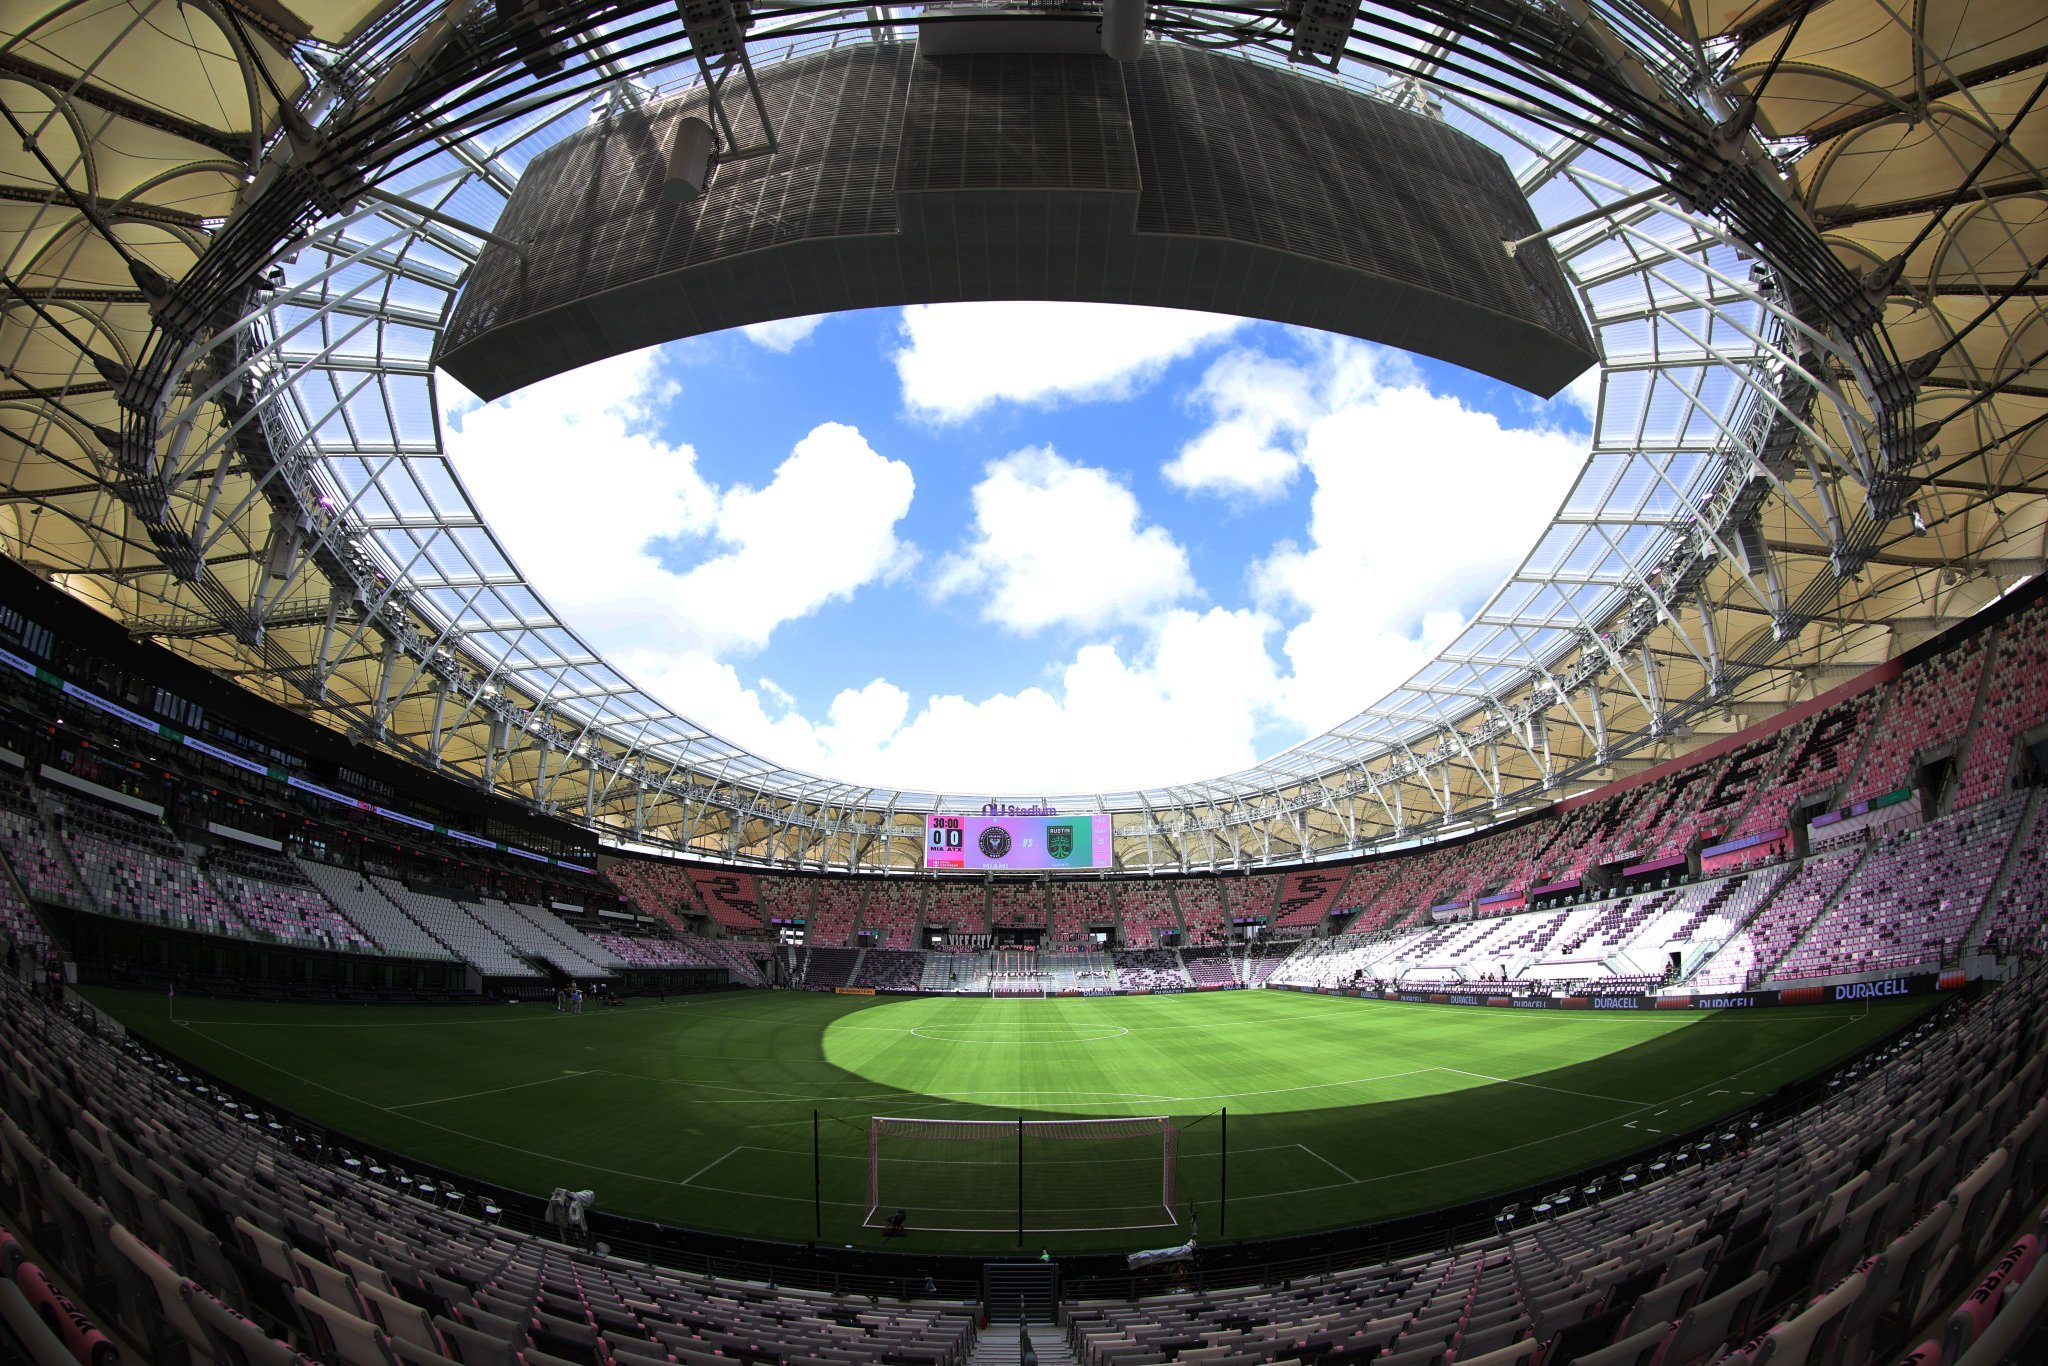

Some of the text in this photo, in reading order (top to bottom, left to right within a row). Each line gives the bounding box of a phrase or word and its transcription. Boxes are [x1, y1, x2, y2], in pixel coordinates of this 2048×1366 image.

[1008, 805, 1056, 816] Stadium
[934, 818, 958, 828] 30:00
[934, 830, 941, 844] 0
[951, 831, 958, 845] 0
[1600, 856, 1612, 865] LEO
[1615, 850, 1637, 862] MESSI
[948, 934, 969, 945] VICE
[971, 934, 992, 948] CITY
[1835, 979, 1908, 1000] DURACELL
[1451, 995, 1477, 1004] DURACELL
[1595, 998, 1638, 1008] DURACELL
[1970, 1244, 2027, 1304] WE'RE
